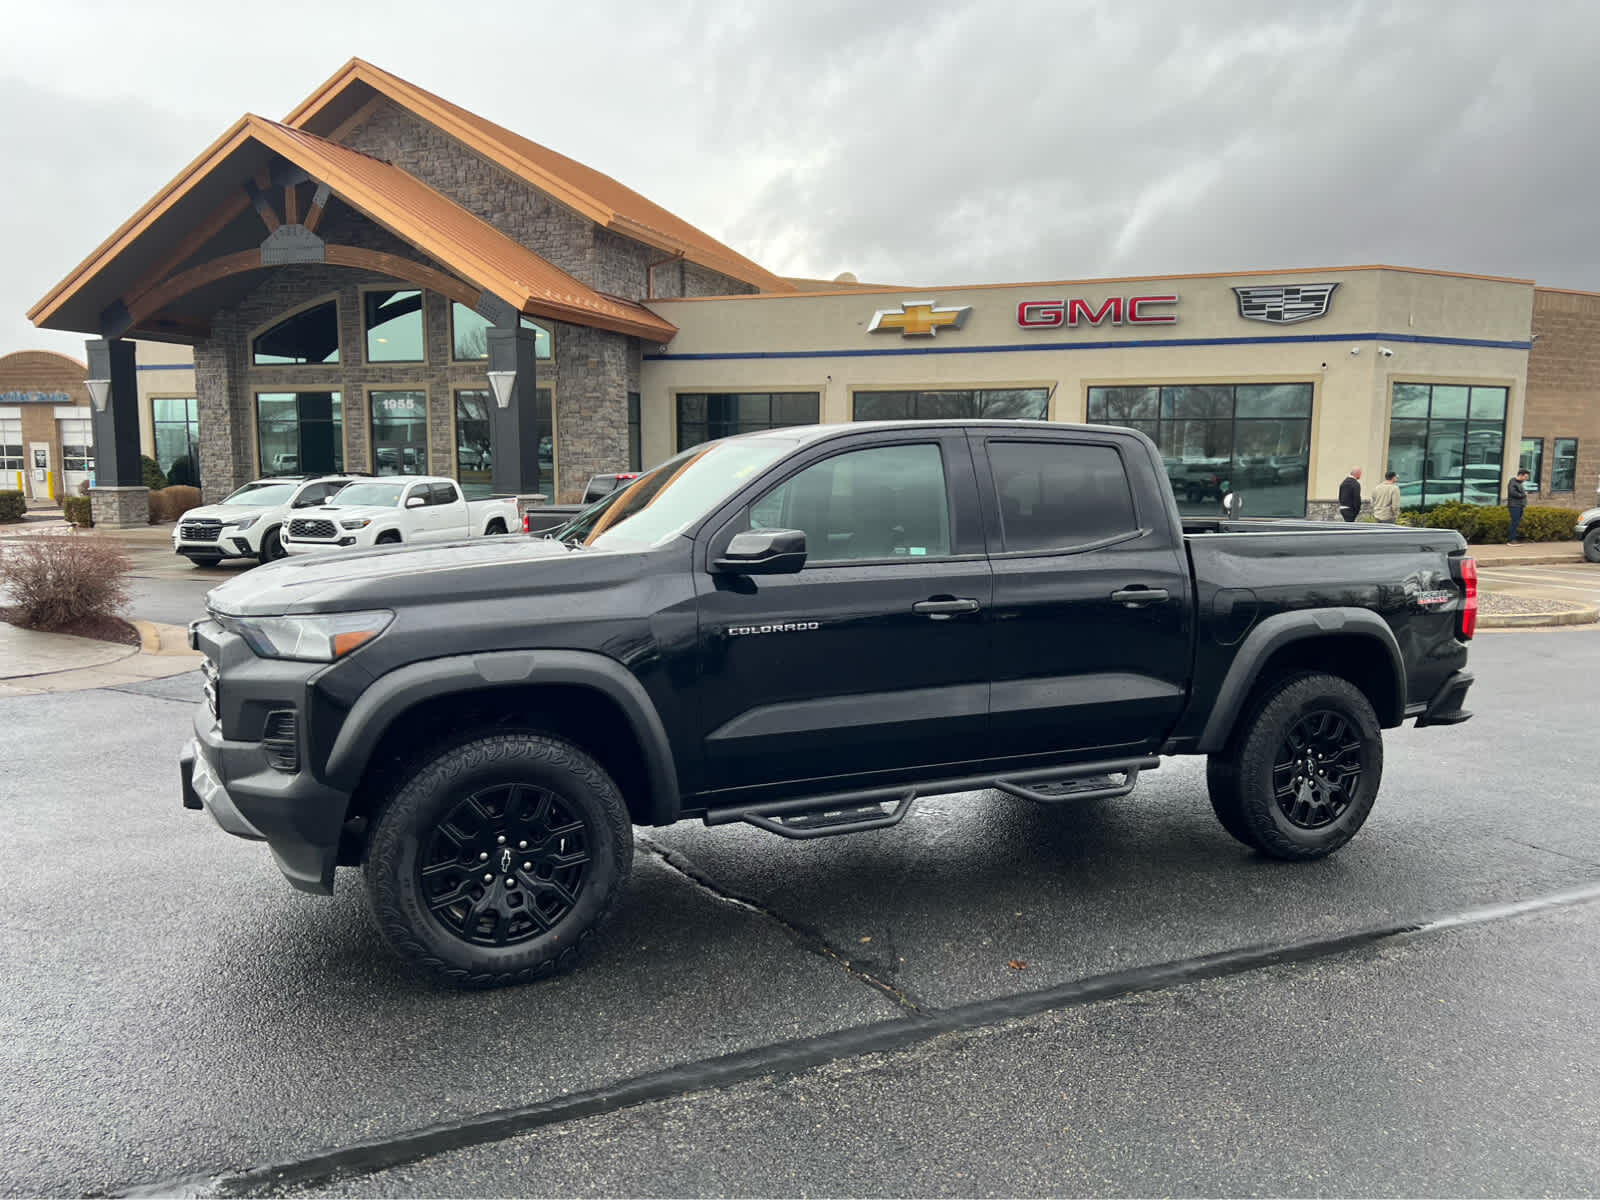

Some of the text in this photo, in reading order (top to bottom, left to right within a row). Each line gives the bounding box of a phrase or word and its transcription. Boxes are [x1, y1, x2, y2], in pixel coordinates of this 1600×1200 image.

[1016, 296, 1178, 329] GMC
[383, 399, 415, 409] 1955
[728, 622, 819, 636] COLORADO
